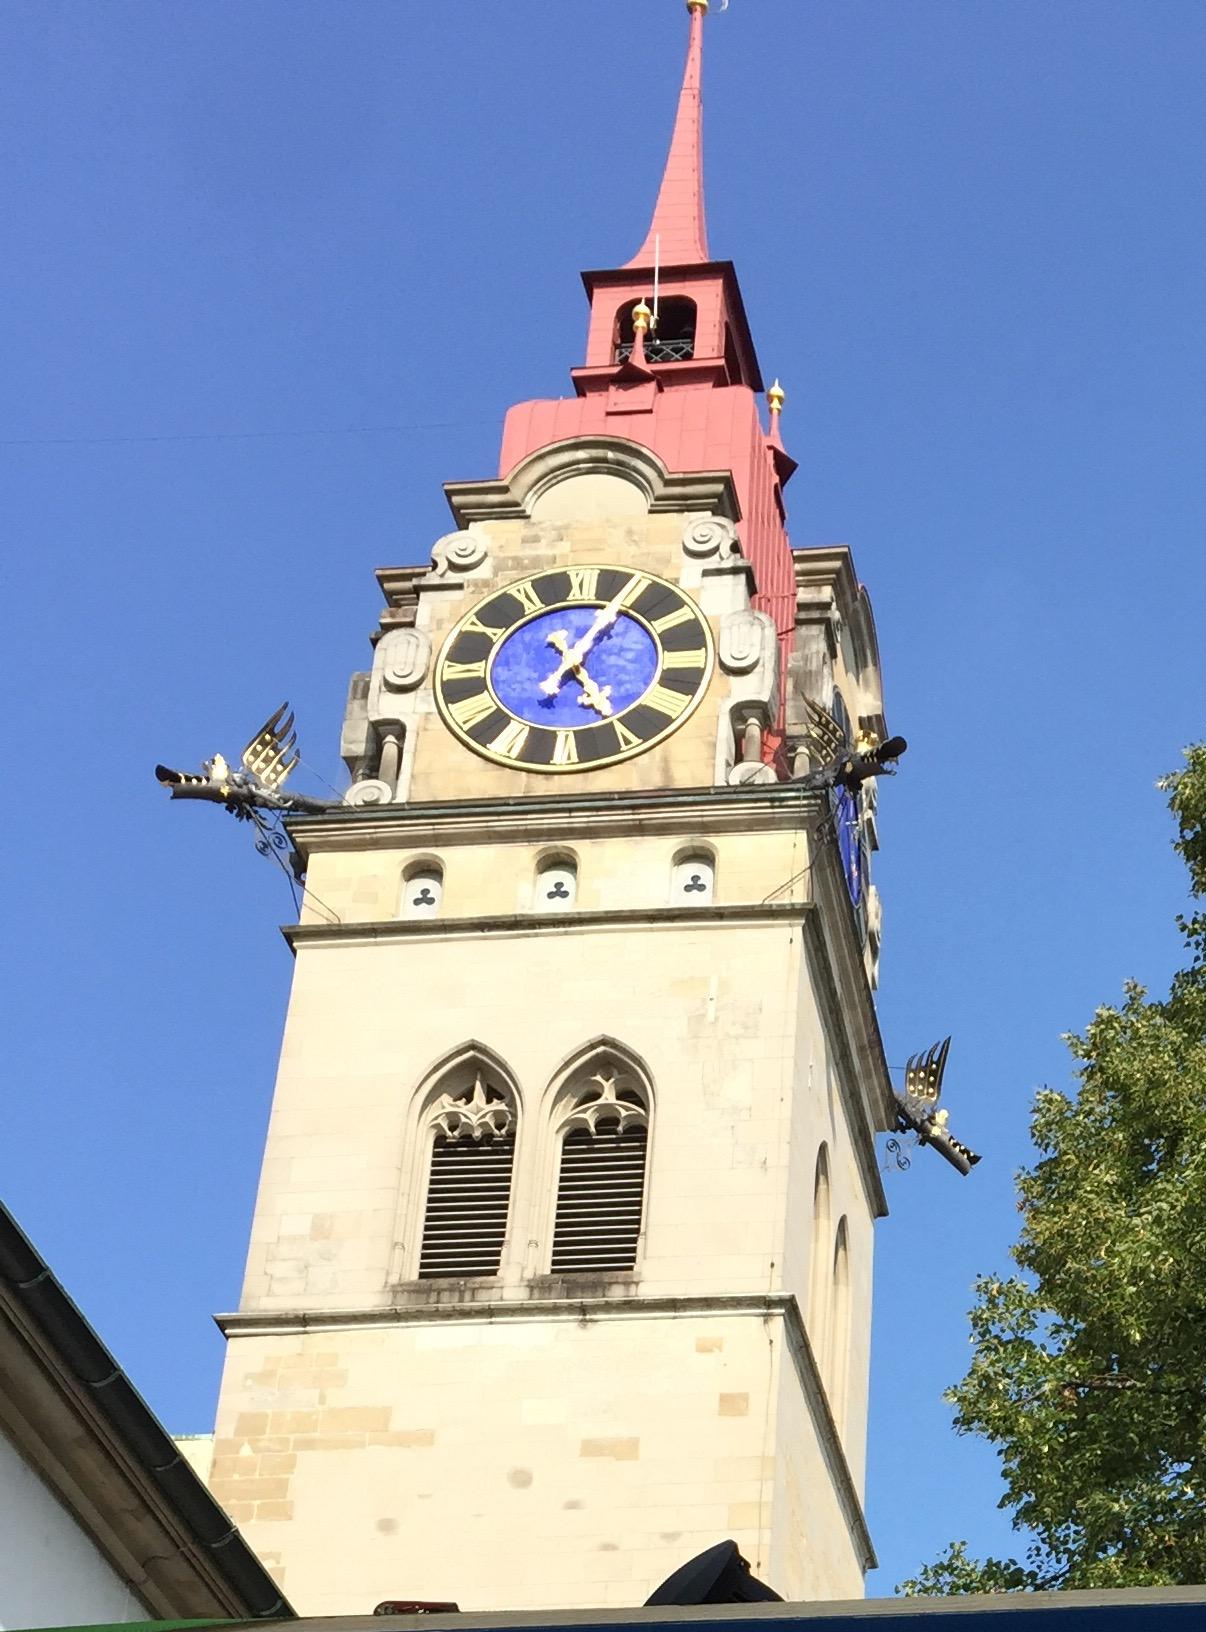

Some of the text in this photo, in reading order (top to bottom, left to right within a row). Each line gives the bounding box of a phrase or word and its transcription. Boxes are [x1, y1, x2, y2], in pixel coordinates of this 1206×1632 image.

[506, 580, 546, 616] XI
[566, 568, 601, 601] XII
[461, 614, 506, 643] X
[662, 646, 706, 670] III
